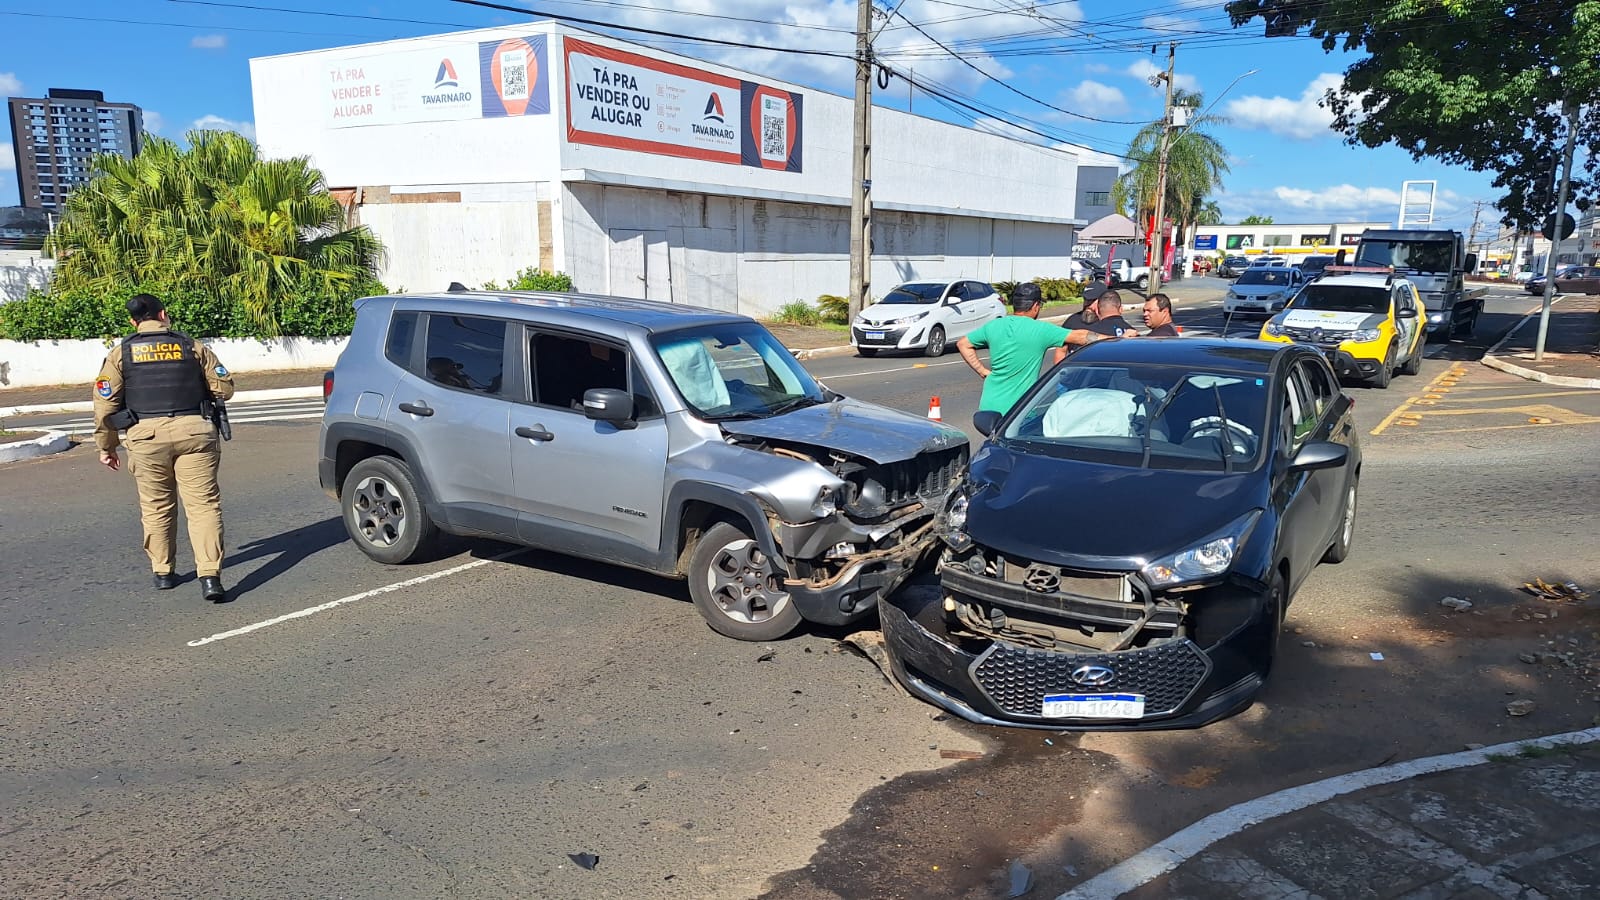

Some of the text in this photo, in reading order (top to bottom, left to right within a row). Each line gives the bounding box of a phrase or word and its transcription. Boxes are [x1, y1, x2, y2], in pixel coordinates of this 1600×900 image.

[346, 68, 365, 80] PRA
[593, 66, 638, 92] TÁ PRA
[331, 85, 371, 100] VENDER
[374, 84, 381, 97] E
[421, 91, 472, 105] TAVARNARO
[576, 83, 629, 108] VENDER
[632, 94, 650, 112] OU
[333, 103, 373, 119] ALUGAR
[591, 105, 642, 128] ALUGAR
[691, 123, 735, 140] TAVARNARO
[133, 342, 182, 353] POLÍCIA
[133, 352, 182, 362] MILITAR
